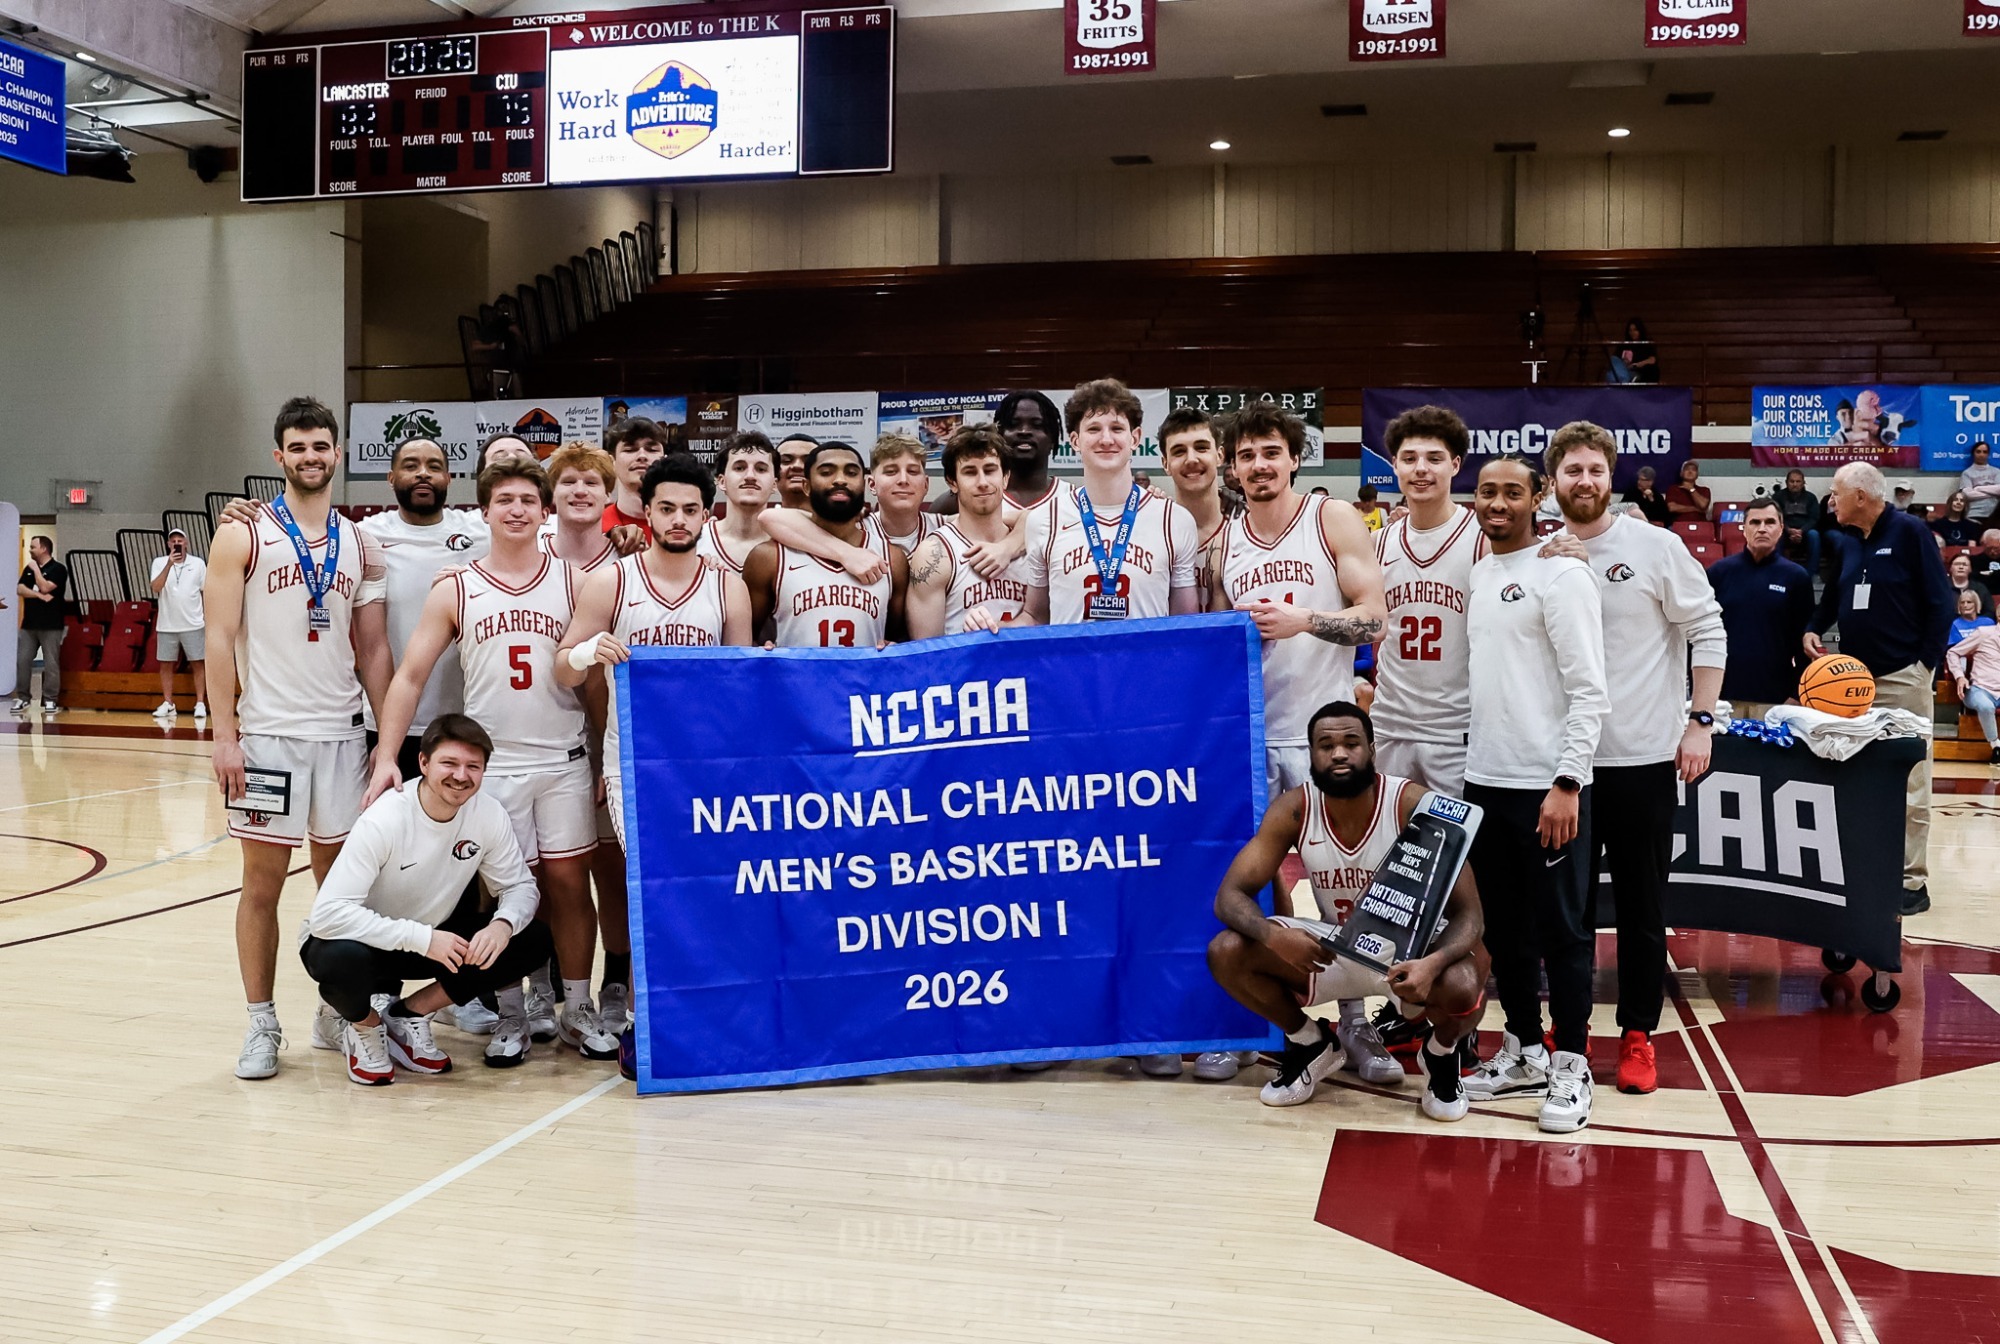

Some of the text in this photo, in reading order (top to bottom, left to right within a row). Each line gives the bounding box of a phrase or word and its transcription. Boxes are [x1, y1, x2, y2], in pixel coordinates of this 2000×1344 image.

[1089, 0, 1131, 21] 35
[1366, 11, 1429, 26] LARSEN
[513, 13, 585, 26] DAKTRONICS
[810, 16, 831, 28] PLYR
[840, 15, 854, 27] FLS
[865, 14, 881, 25] PTS
[1967, 14, 2000, 29] 199
[589, 14, 780, 43] WELCOME to THE K
[1083, 25, 1137, 39] FRITTS
[1651, 23, 1740, 40] 1996-1999
[1358, 37, 1438, 54] 1987-1991
[250, 56, 267, 67] PLYR
[274, 55, 286, 65] FLS
[296, 53, 309, 63] PTS
[391, 39, 472, 74] 20:26
[1073, 51, 1149, 68] 1987-1991
[496, 73, 518, 90] CIU
[6, 81, 54, 107] CHAMPION
[323, 82, 389, 102] LANCASTER
[415, 87, 447, 99] PERIOD
[557, 89, 619, 110] Work
[631, 103, 714, 127] ADVENTURE
[472, 131, 495, 142] T.O.L.
[506, 129, 535, 140] FOULS
[559, 120, 617, 140] Hard
[330, 138, 357, 151] FOULS
[368, 137, 391, 149] T.O.L.
[402, 133, 464, 146] PLAYER FOUL
[719, 141, 792, 158] Harder!
[417, 176, 446, 187] MATCH
[502, 171, 531, 183] SCORE
[329, 181, 357, 192] SCORE
[881, 401, 907, 410] PROUD
[909, 398, 945, 407] SPONSOR
[960, 395, 986, 404] NCCAA
[1763, 395, 1825, 408] OUR COWS.
[565, 404, 599, 418] Adventure
[771, 406, 864, 421] Higginbotham
[1763, 410, 1831, 423] OUR CREAM.
[476, 422, 510, 434] Work
[1763, 425, 1834, 438] YOUR SMILE.
[1367, 475, 1393, 485] NCCAA
[1088, 525, 1100, 547] NCCAA
[1117, 523, 1129, 545] NCCAA
[294, 535, 308, 557] NCCAA
[1107, 557, 1119, 579] NCCAA
[1232, 560, 1314, 601] CHARGERS
[793, 584, 880, 620] CHARGERS
[1091, 595, 1126, 608] NCCAA
[1386, 580, 1464, 615] CHARGERS
[475, 609, 563, 645] CHARGERS
[629, 623, 713, 647] CHARGERS
[818, 619, 855, 647] 13
[1400, 616, 1442, 661] 22
[508, 645, 533, 691] 5
[849, 677, 1029, 747] NCCAA
[693, 767, 1196, 834] NATIONAL CHAMPION
[1430, 796, 1469, 820] NCCAA
[1401, 841, 1428, 859] DIVISION
[735, 834, 1161, 895] MEN'S BASKETBALL
[1401, 853, 1422, 868] MEN'S
[1388, 861, 1424, 883] BASKETBALL
[1369, 882, 1417, 912] NATIONAL
[1360, 896, 1413, 928] CHAMPION
[838, 900, 1067, 953] DIVISION I
[1355, 934, 1382, 955] 2026
[904, 969, 1009, 1011] 2026
